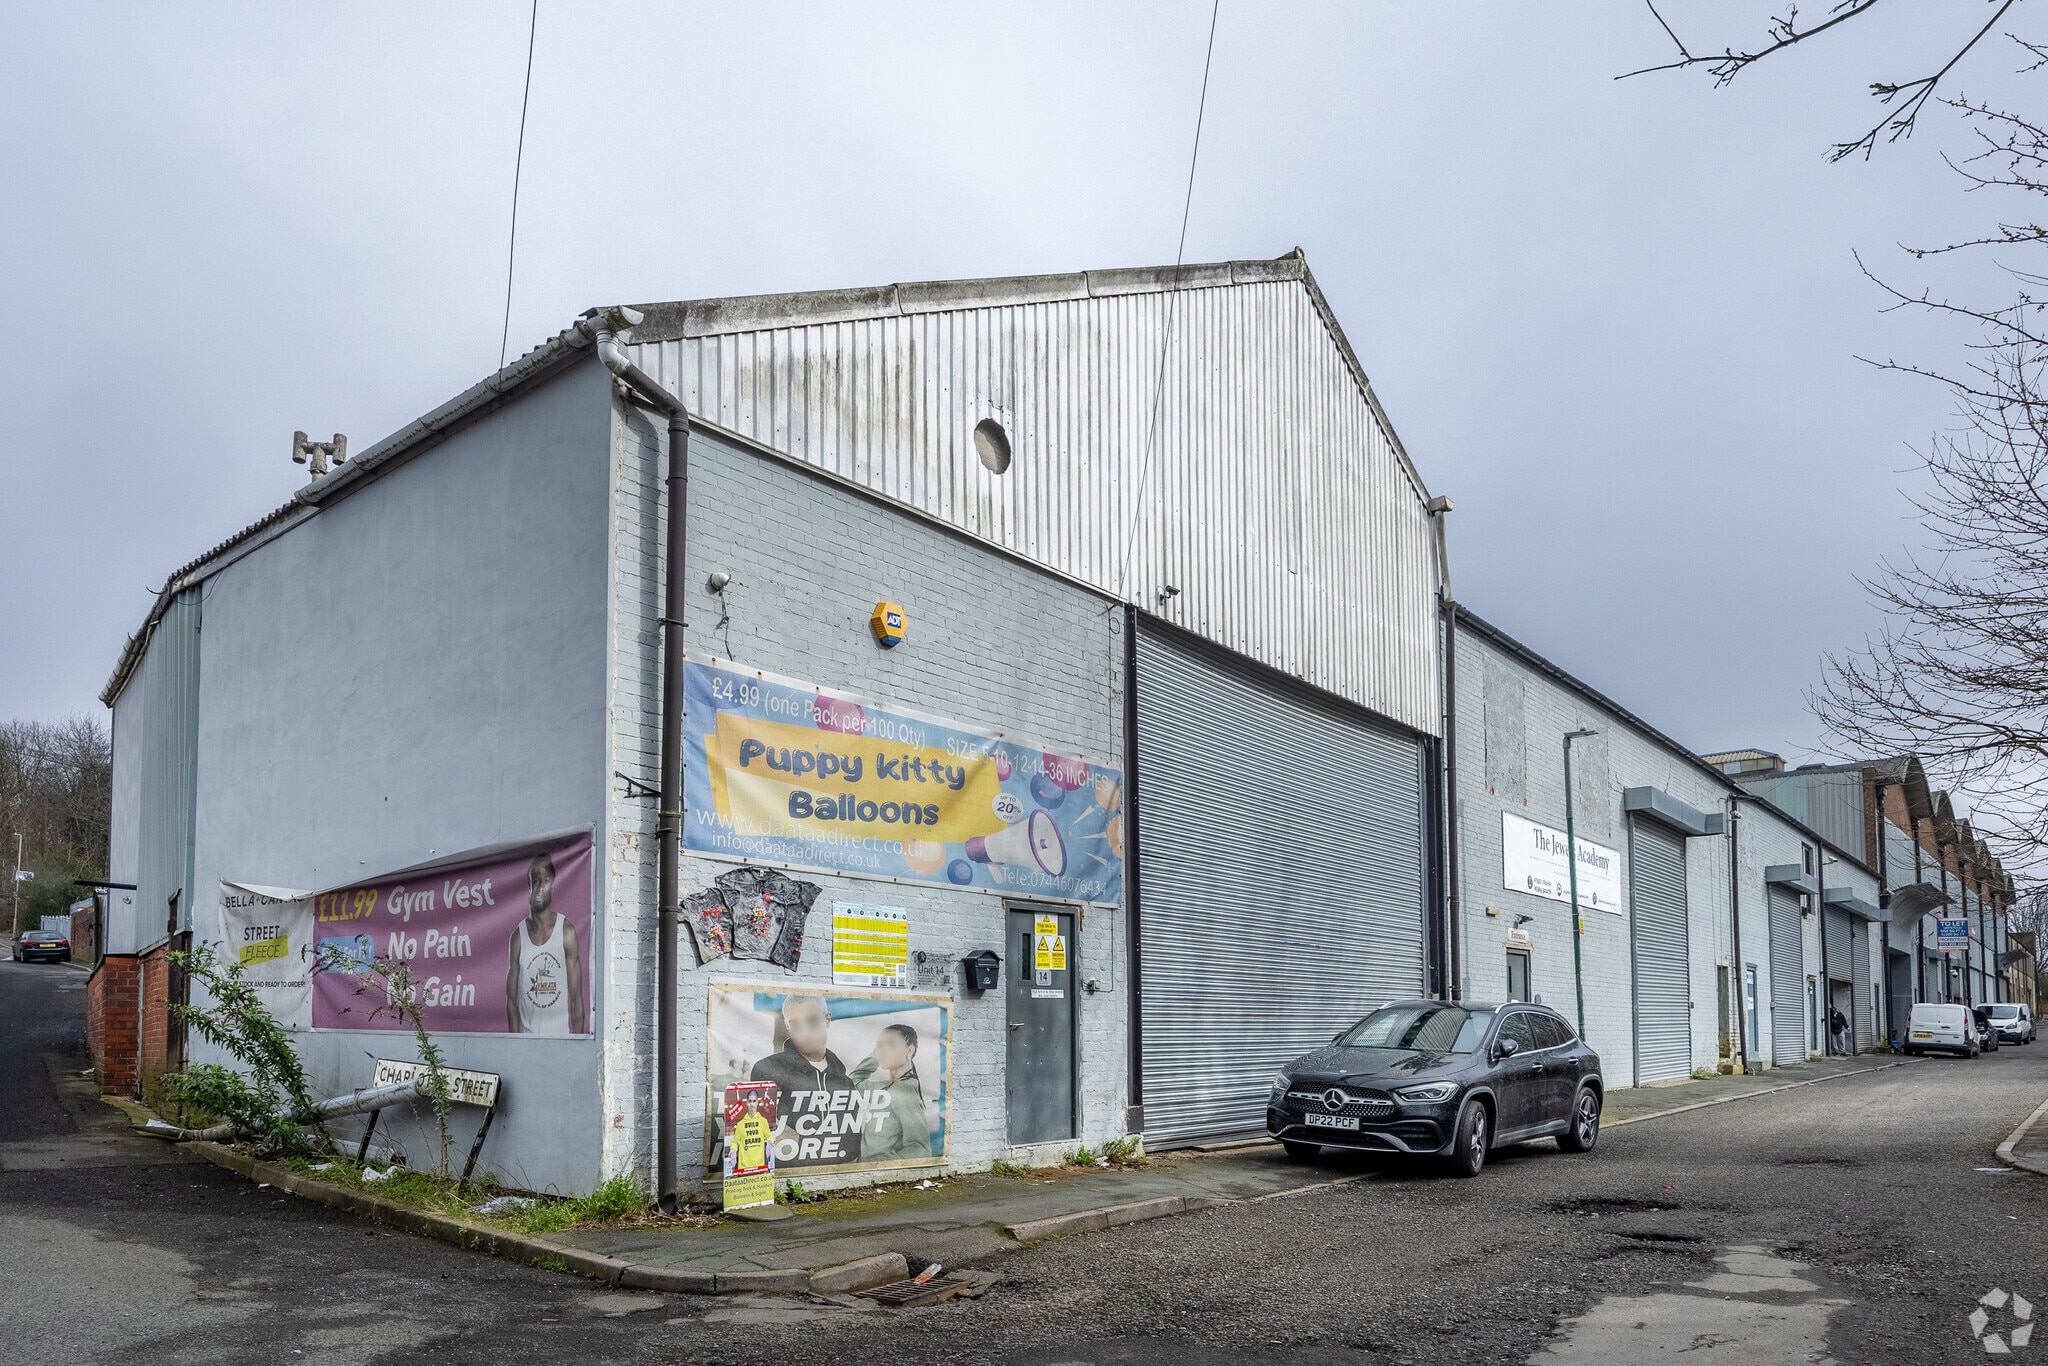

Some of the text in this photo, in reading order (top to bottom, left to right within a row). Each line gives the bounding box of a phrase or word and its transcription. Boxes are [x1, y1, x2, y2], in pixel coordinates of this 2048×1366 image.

[887, 614, 901, 627] ADT
[712, 676, 760, 707] £4.99
[764, 689, 799, 717] (one
[804, 699, 838, 727] Pack
[842, 713, 866, 733] per
[870, 720, 895, 739] 100
[898, 724, 926, 752] Qty)
[947, 737, 979, 761] SIZE
[1066, 771, 1111, 792] INCHES
[739, 738, 966, 791] Puppy kitty
[788, 790, 939, 825] Balloons
[997, 801, 1021, 814] 20%
[696, 809, 928, 859] www.daataadirect.co.uk
[712, 829, 881, 869] info@daataadirect.co.uk
[1533, 828, 1550, 852] The
[1551, 834, 1571, 857] Jewe
[1577, 843, 1610, 875] Academy
[318, 878, 495, 923] £11.99 Gym Vest
[244, 925, 280, 941] STREET
[388, 926, 471, 960] No Pain
[245, 944, 280, 960] FLEECE
[917, 965, 944, 975] Unit 14
[1039, 971, 1048, 981] 14
[423, 974, 475, 1007] Gain
[453, 1077, 493, 1098] STREET
[790, 1089, 892, 1113] TREND
[795, 1111, 891, 1136] CAN'T
[1309, 1114, 1355, 1128] DP22 PCF
[744, 1137, 761, 1145] BRAND
